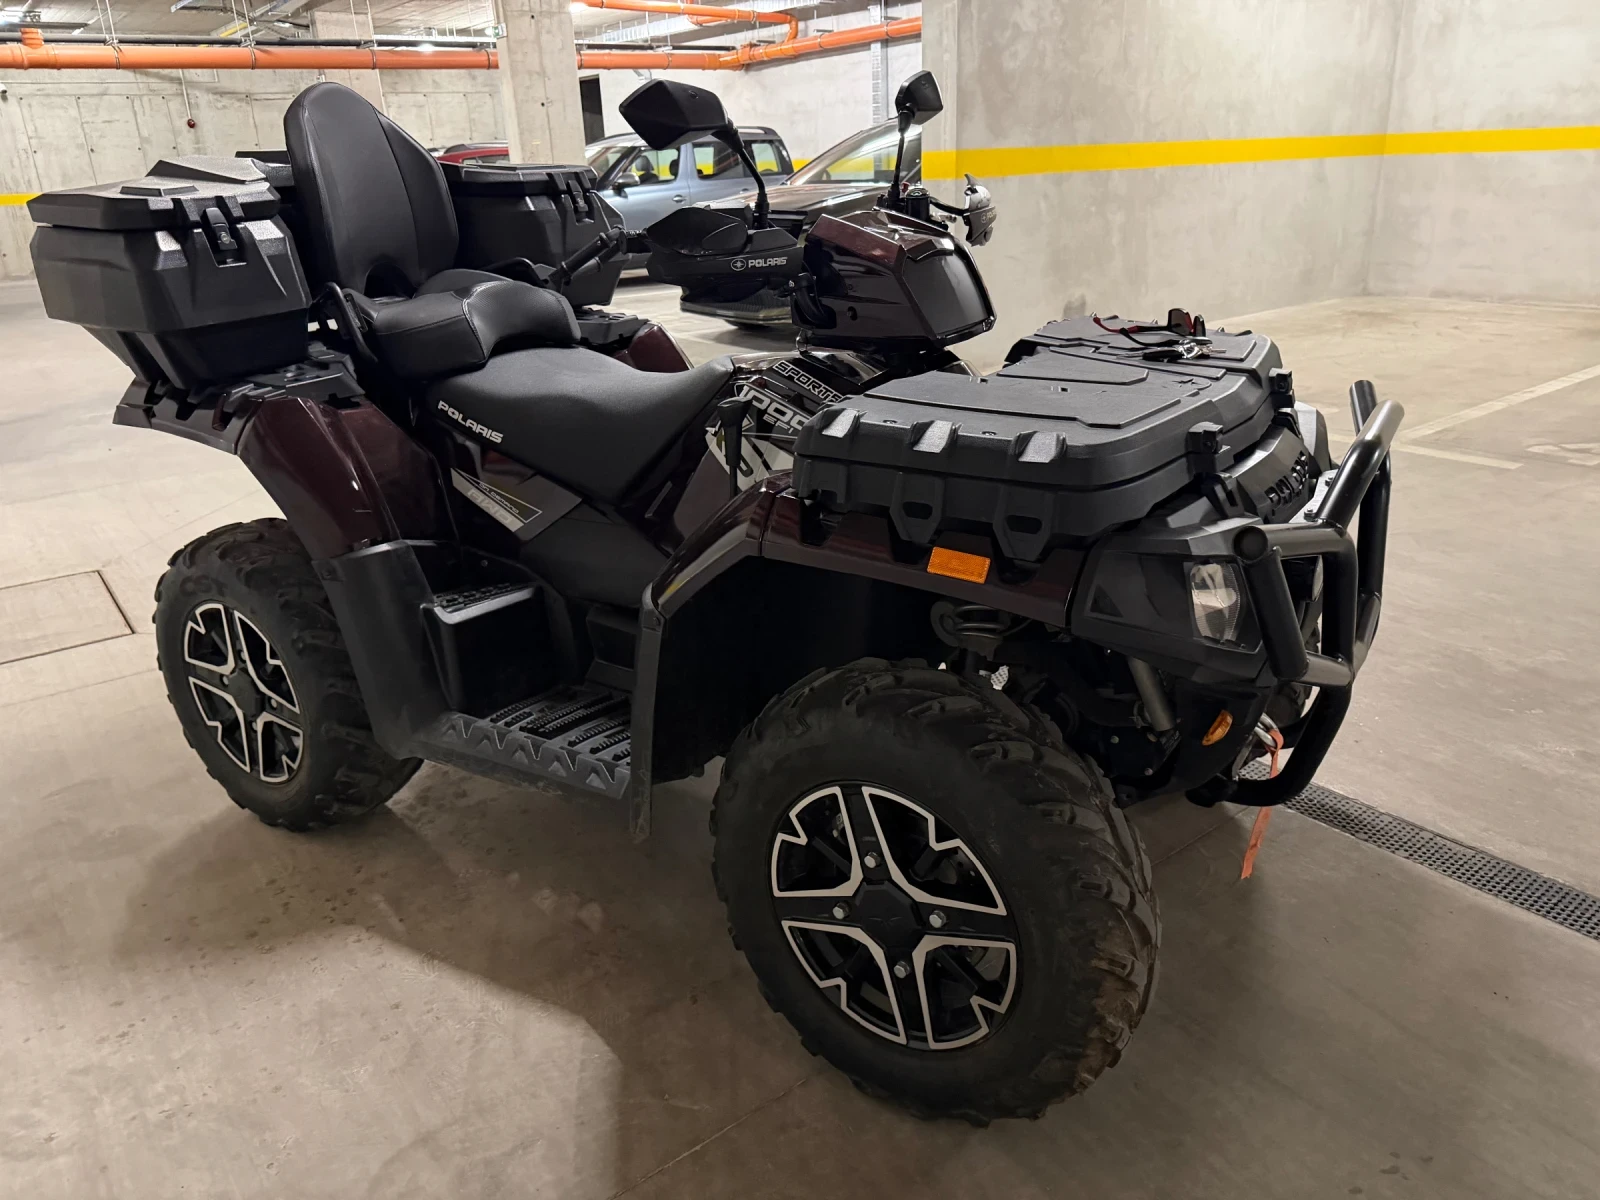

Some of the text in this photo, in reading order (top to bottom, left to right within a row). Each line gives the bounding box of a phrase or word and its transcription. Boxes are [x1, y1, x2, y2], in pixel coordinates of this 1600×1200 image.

[748, 257, 788, 268] POLARIS
[438, 400, 504, 443] POLARIS
[763, 414, 794, 434] EFI
[467, 488, 513, 524] AWD
